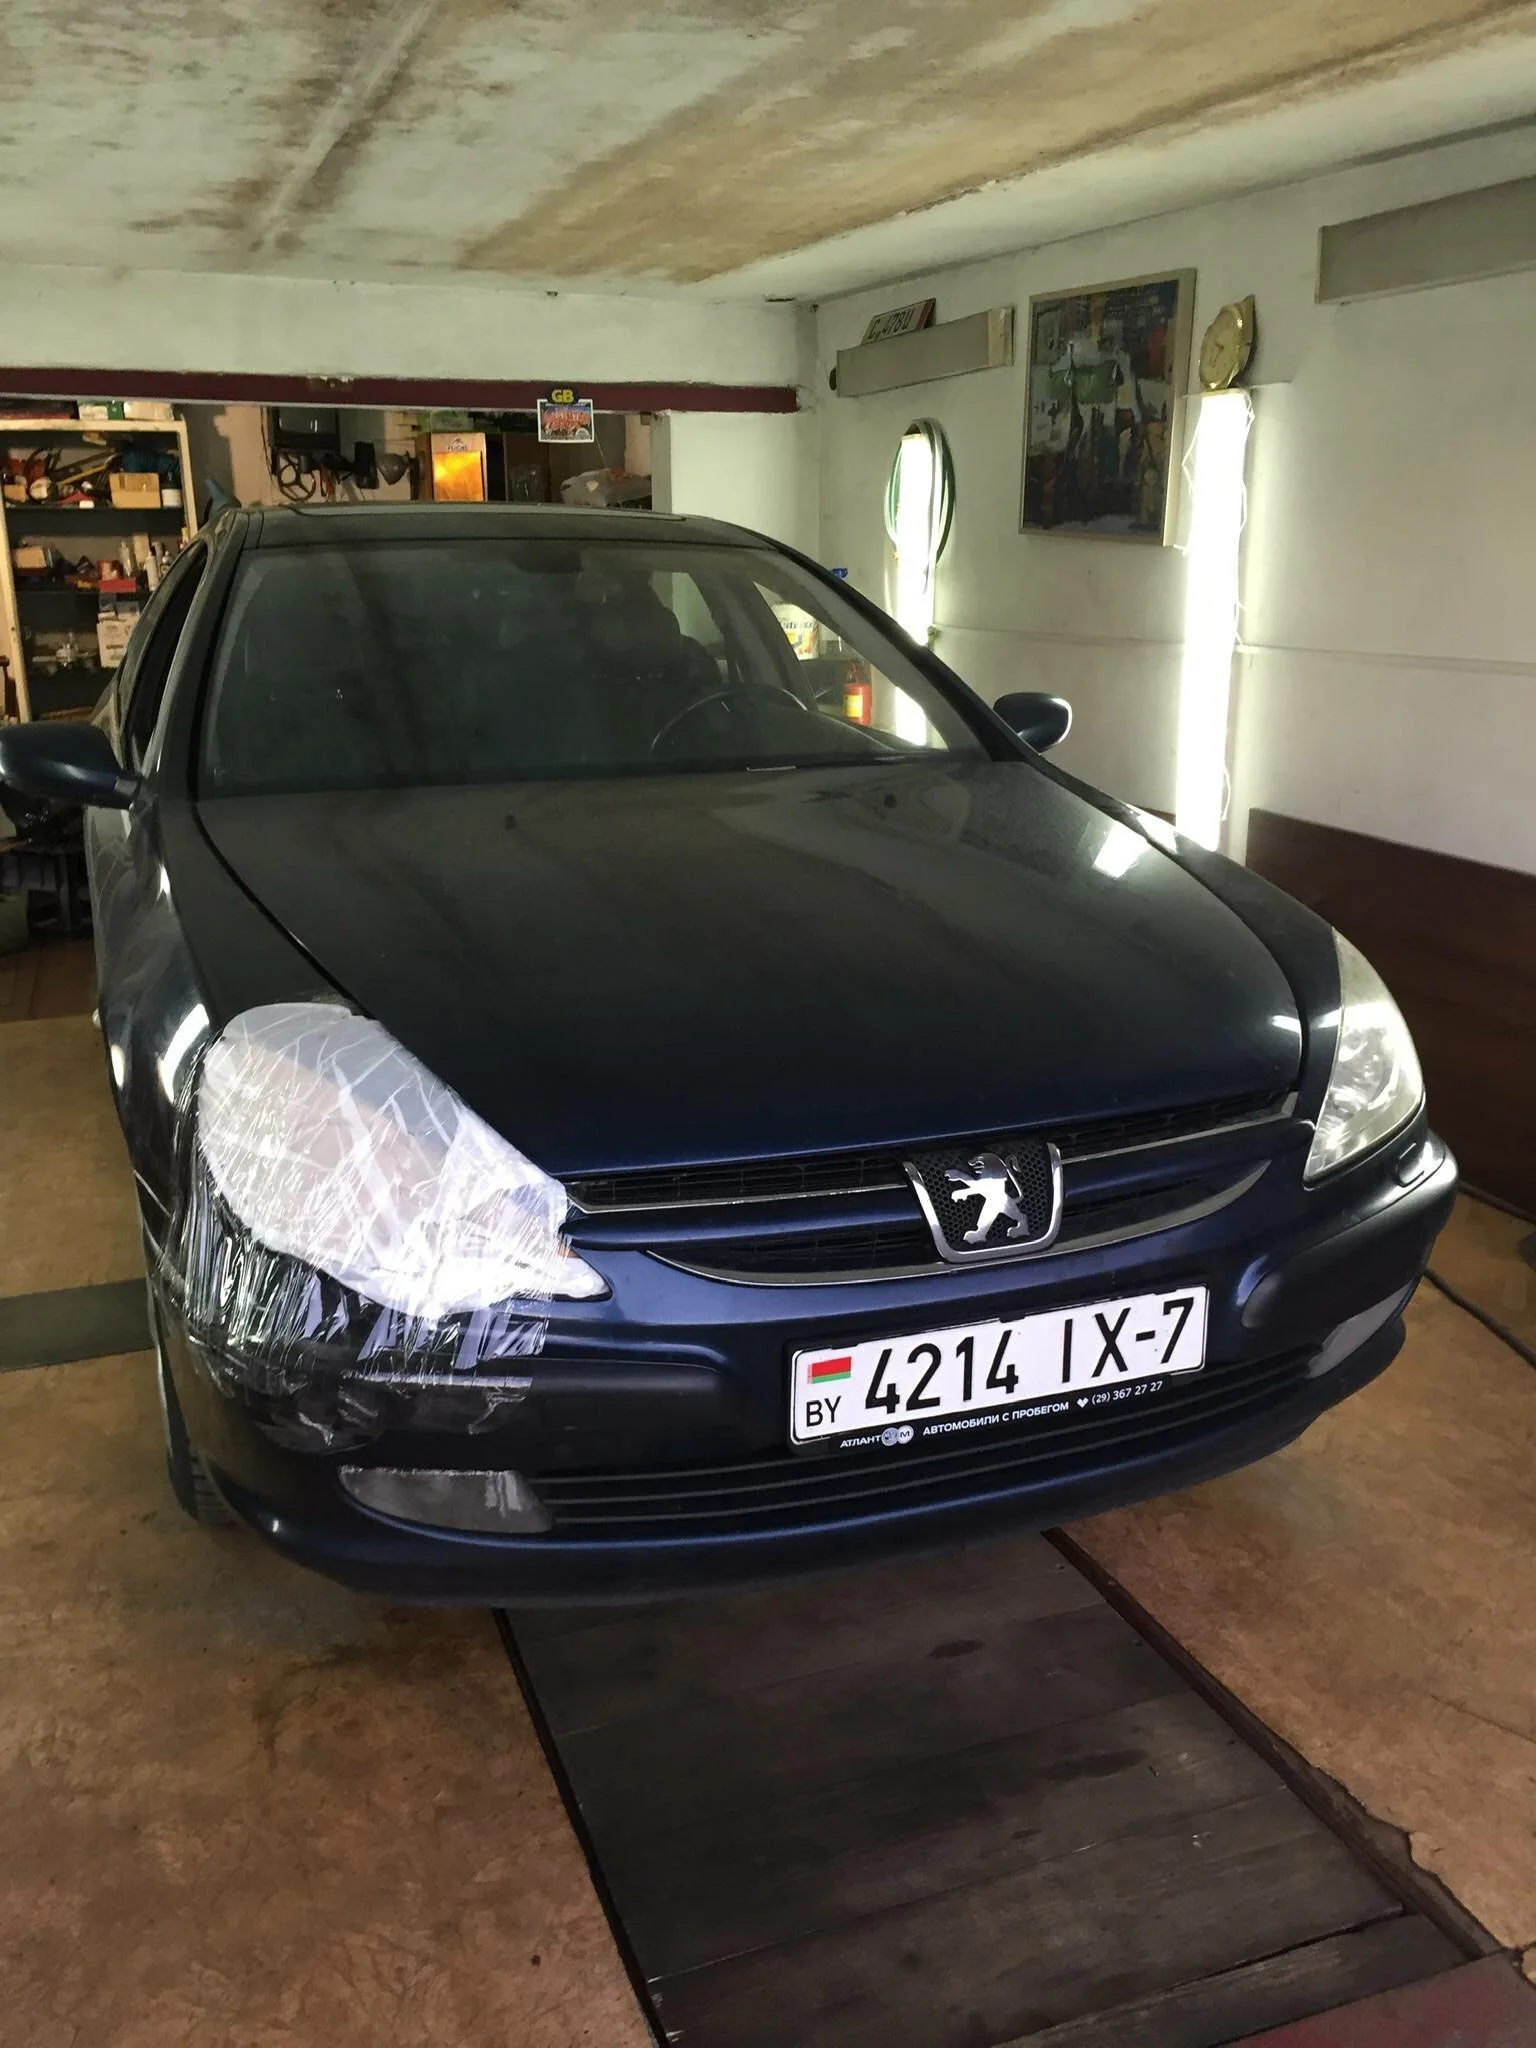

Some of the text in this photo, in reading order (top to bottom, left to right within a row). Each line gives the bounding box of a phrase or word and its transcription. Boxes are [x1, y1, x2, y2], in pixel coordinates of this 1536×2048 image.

[552, 389, 574, 403] GB
[865, 1297, 1196, 1414] 4214 IX-7
[806, 1396, 841, 1428] BY
[923, 1380, 1163, 1436] АВТОМОБИЛИ С ПРОБЕГОМ (29) 367 27 27
